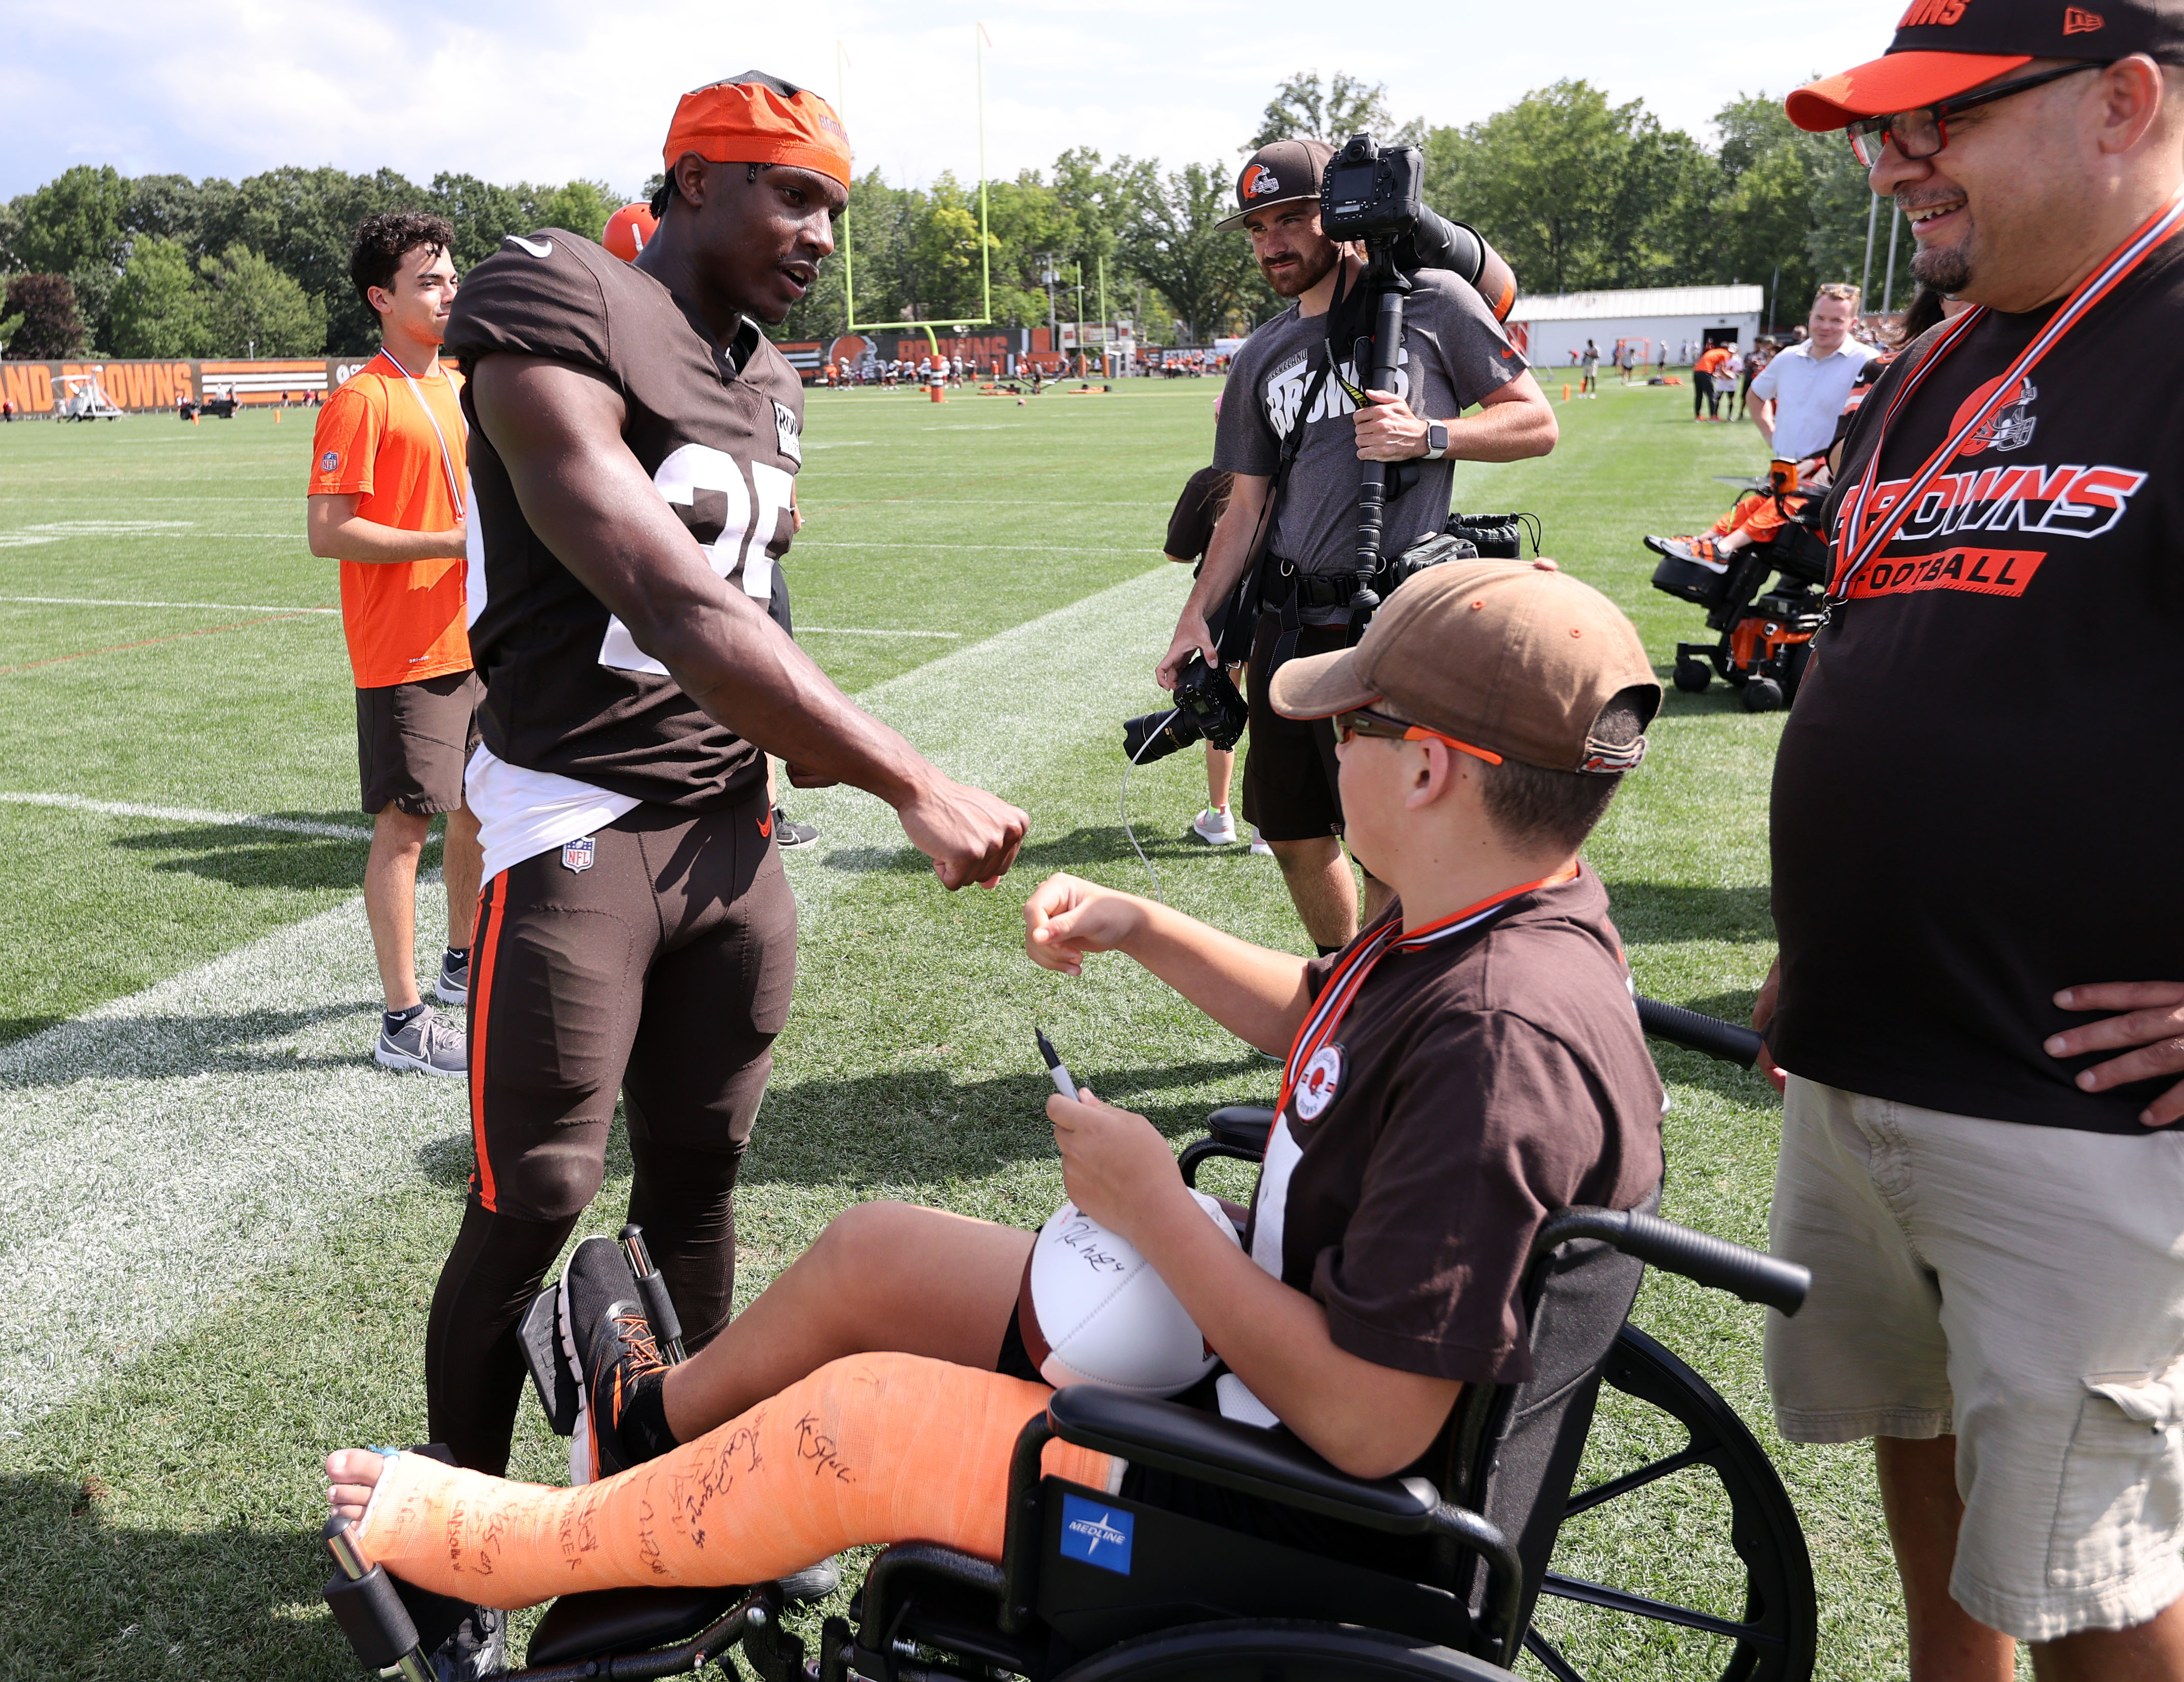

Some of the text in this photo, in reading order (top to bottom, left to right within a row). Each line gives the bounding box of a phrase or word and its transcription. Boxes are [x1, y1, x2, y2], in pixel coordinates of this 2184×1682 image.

[1266, 348, 1308, 382] CLEVELAND
[0, 364, 54, 413] ND
[1266, 347, 1409, 440] BROWS
[323, 460, 337, 469] NFL
[409, 656, 429, 664] DRI-FIT
[568, 850, 589, 865] NFL
[1069, 1520, 1126, 1545] MEDLINE
